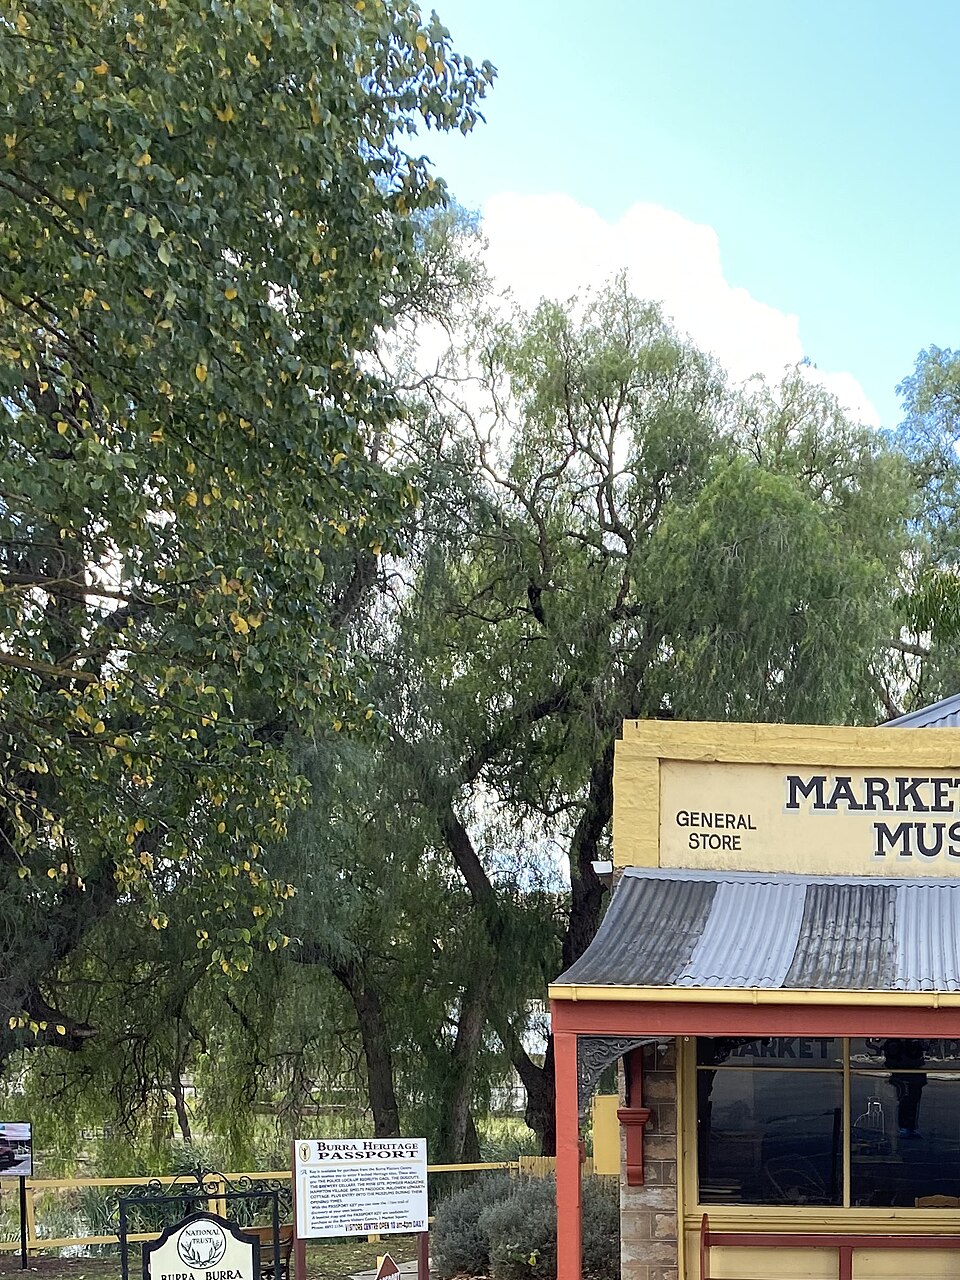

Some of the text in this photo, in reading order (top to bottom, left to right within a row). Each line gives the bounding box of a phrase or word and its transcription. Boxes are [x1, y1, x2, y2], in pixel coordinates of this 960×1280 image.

[675, 810, 757, 831] GENERAL
[688, 833, 742, 851] STORE
[728, 1037, 835, 1059] ARKET
[316, 1141, 419, 1152] BURRA HERITAGE
[318, 1150, 419, 1160] PASSPORT
[185, 1229, 220, 1237] NATIONAL
[205, 1269, 243, 1280] BURRA
